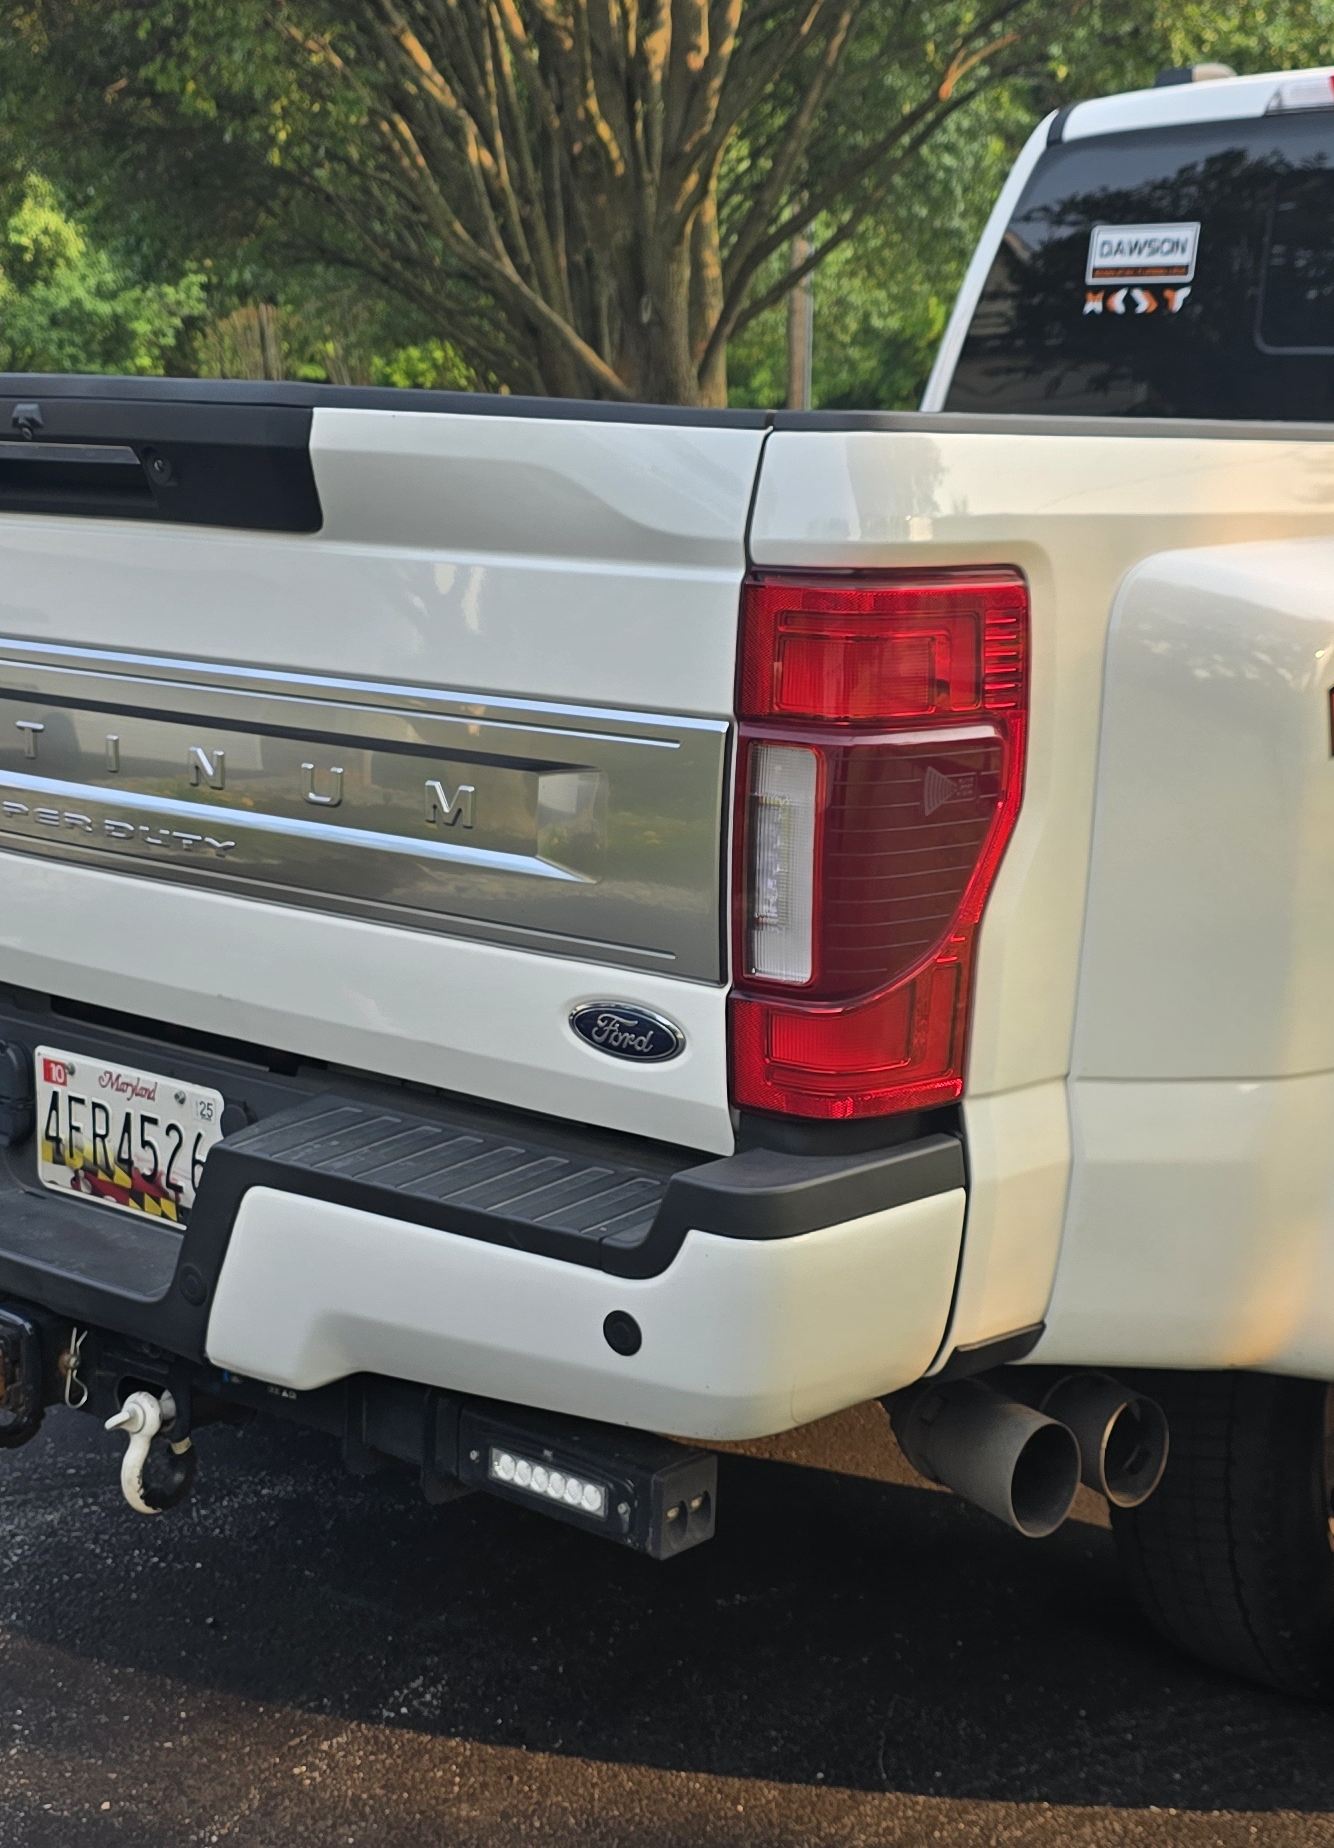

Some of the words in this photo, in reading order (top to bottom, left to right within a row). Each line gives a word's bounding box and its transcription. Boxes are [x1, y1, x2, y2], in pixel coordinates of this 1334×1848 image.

[1099, 237, 1189, 259] DAWSON
[104, 818, 237, 859] DUTY
[591, 1013, 654, 1053] Ford
[50, 1062, 65, 1083] 10
[98, 1070, 158, 1101] Maryland
[199, 1100, 214, 1119] 25
